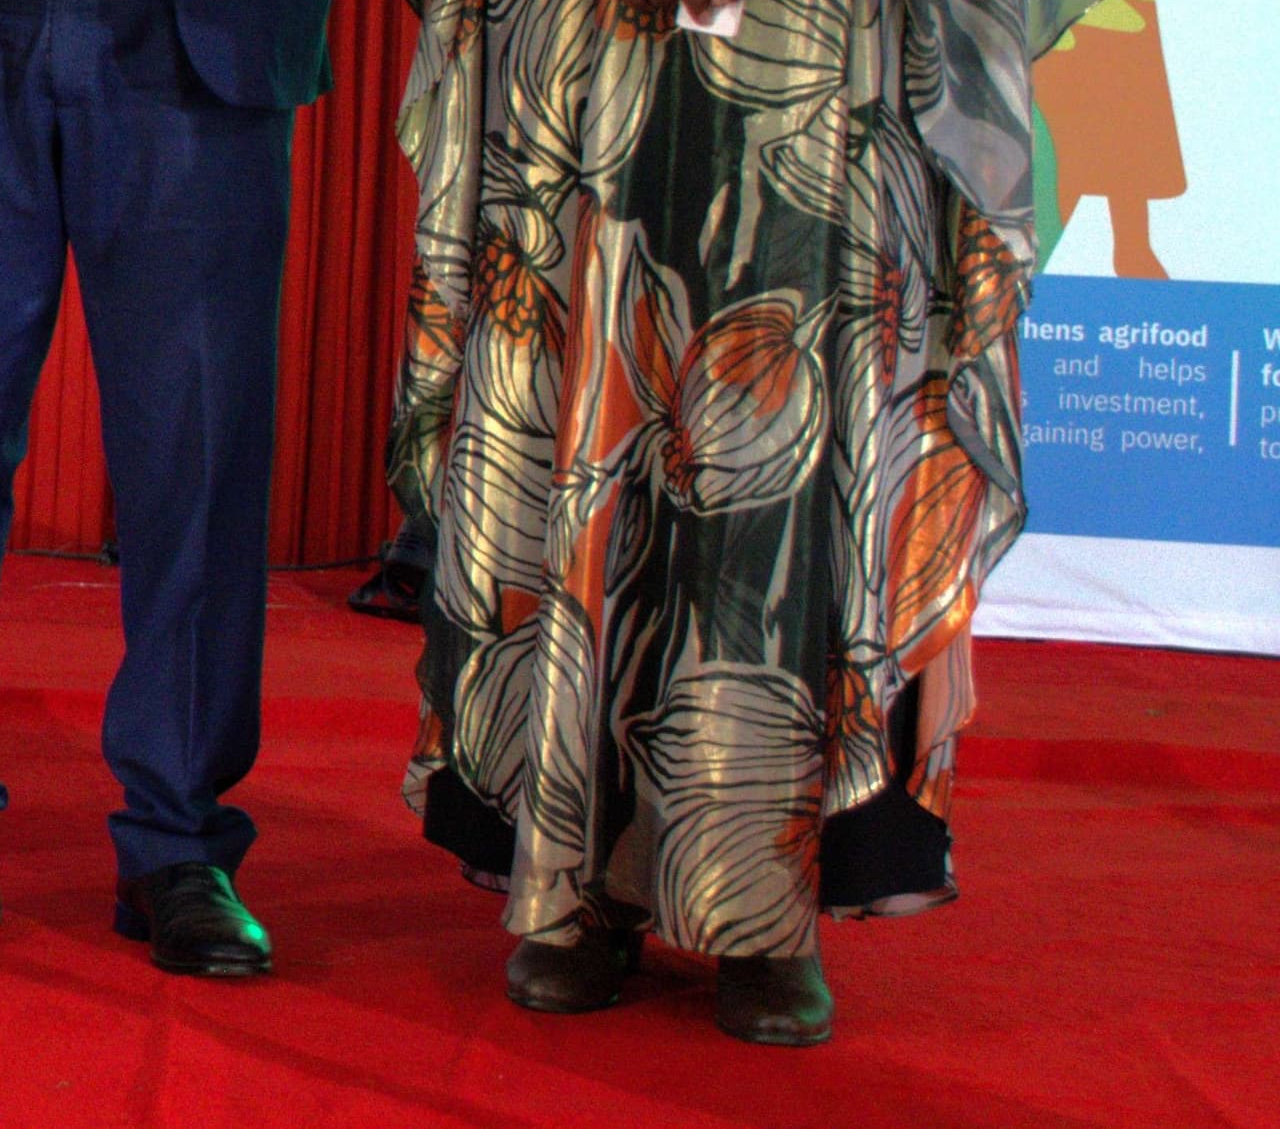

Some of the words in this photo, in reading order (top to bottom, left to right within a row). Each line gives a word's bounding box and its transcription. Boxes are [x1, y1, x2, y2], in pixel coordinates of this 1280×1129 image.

[1023, 316, 1085, 342] hens
[1098, 321, 1208, 349] agrifood
[1053, 354, 1100, 377] and
[1139, 355, 1207, 386] helps
[1058, 386, 1205, 420] investment,
[1121, 427, 1203, 455] power,
